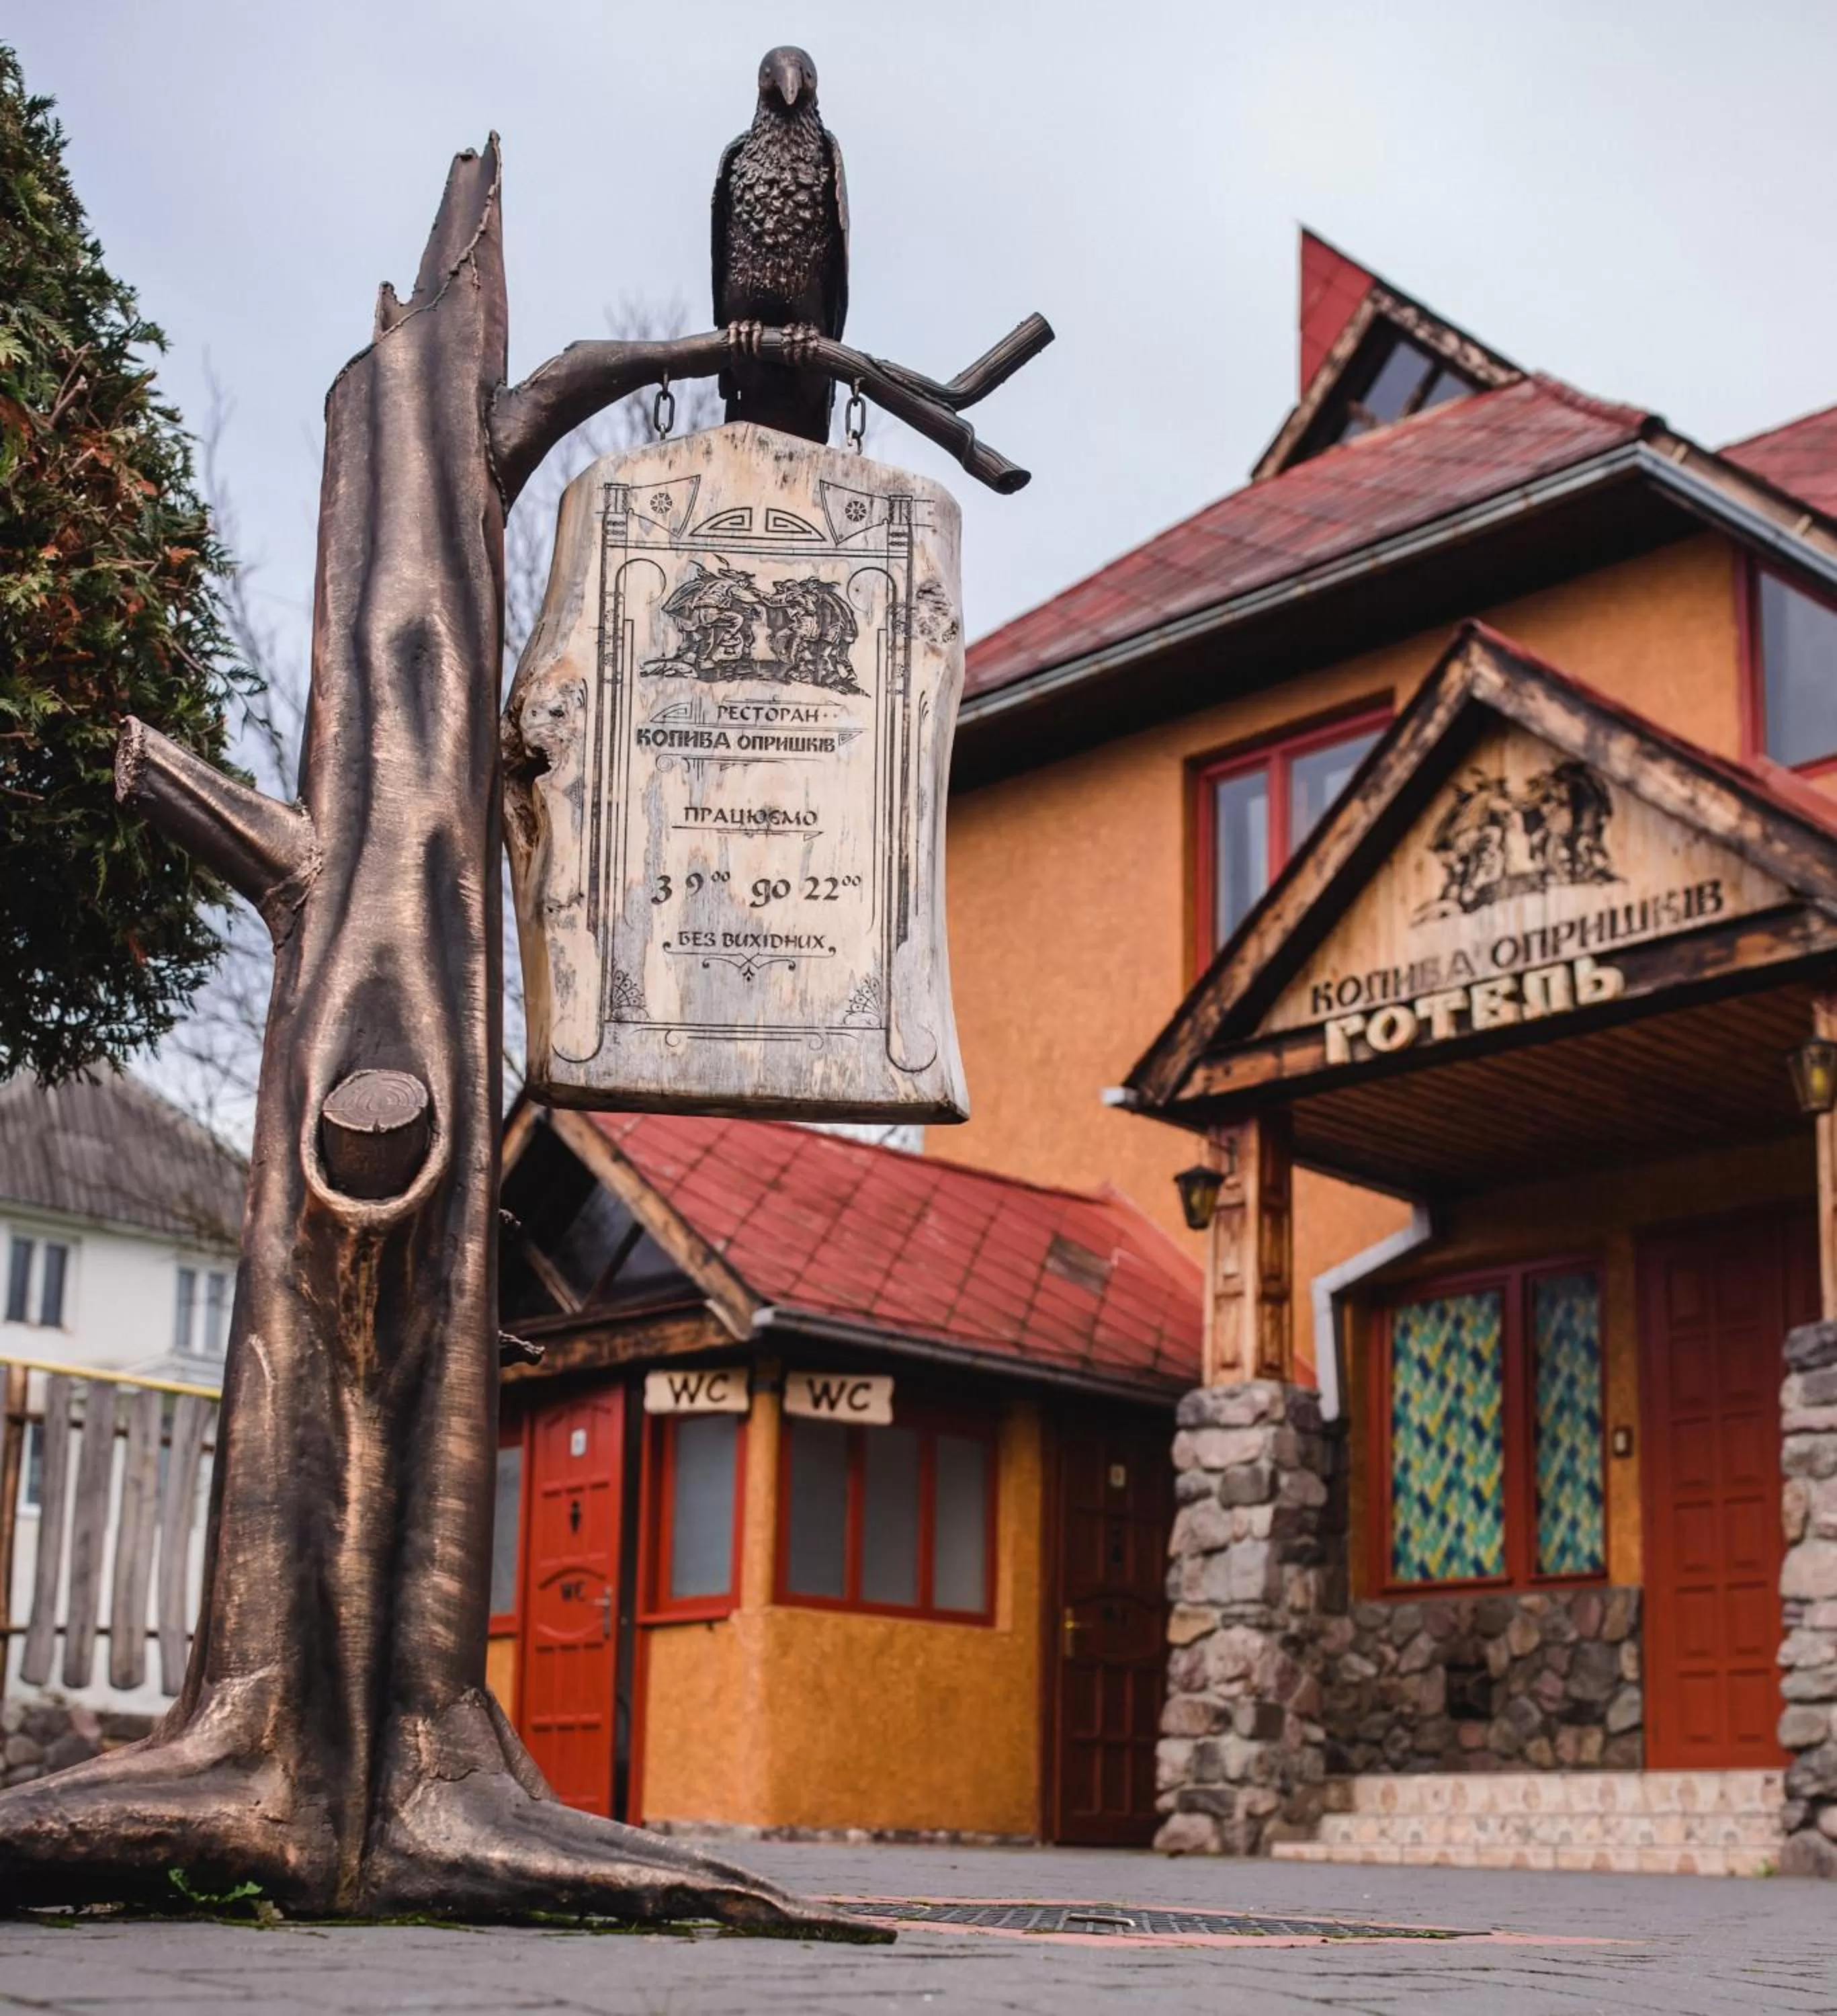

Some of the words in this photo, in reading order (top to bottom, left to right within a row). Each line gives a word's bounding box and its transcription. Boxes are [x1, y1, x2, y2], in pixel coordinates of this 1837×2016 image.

[717, 705, 819, 723] РЕСТОРАН
[636, 728, 731, 749] КОЛИБА
[737, 734, 835, 752] ОПРИШКІВ
[683, 806, 818, 826] ПРАЦЮЄМО
[1490, 880, 1724, 968] ОПРИШКІВ
[677, 931, 716, 947] БЕЗ
[722, 932, 826, 949] ВИХІДНИХ
[1324, 955, 1626, 1065] ГОТЕЛЬ
[667, 1372, 730, 1404] WC
[806, 1378, 872, 1411] WC
[560, 1581, 587, 1602] WC
